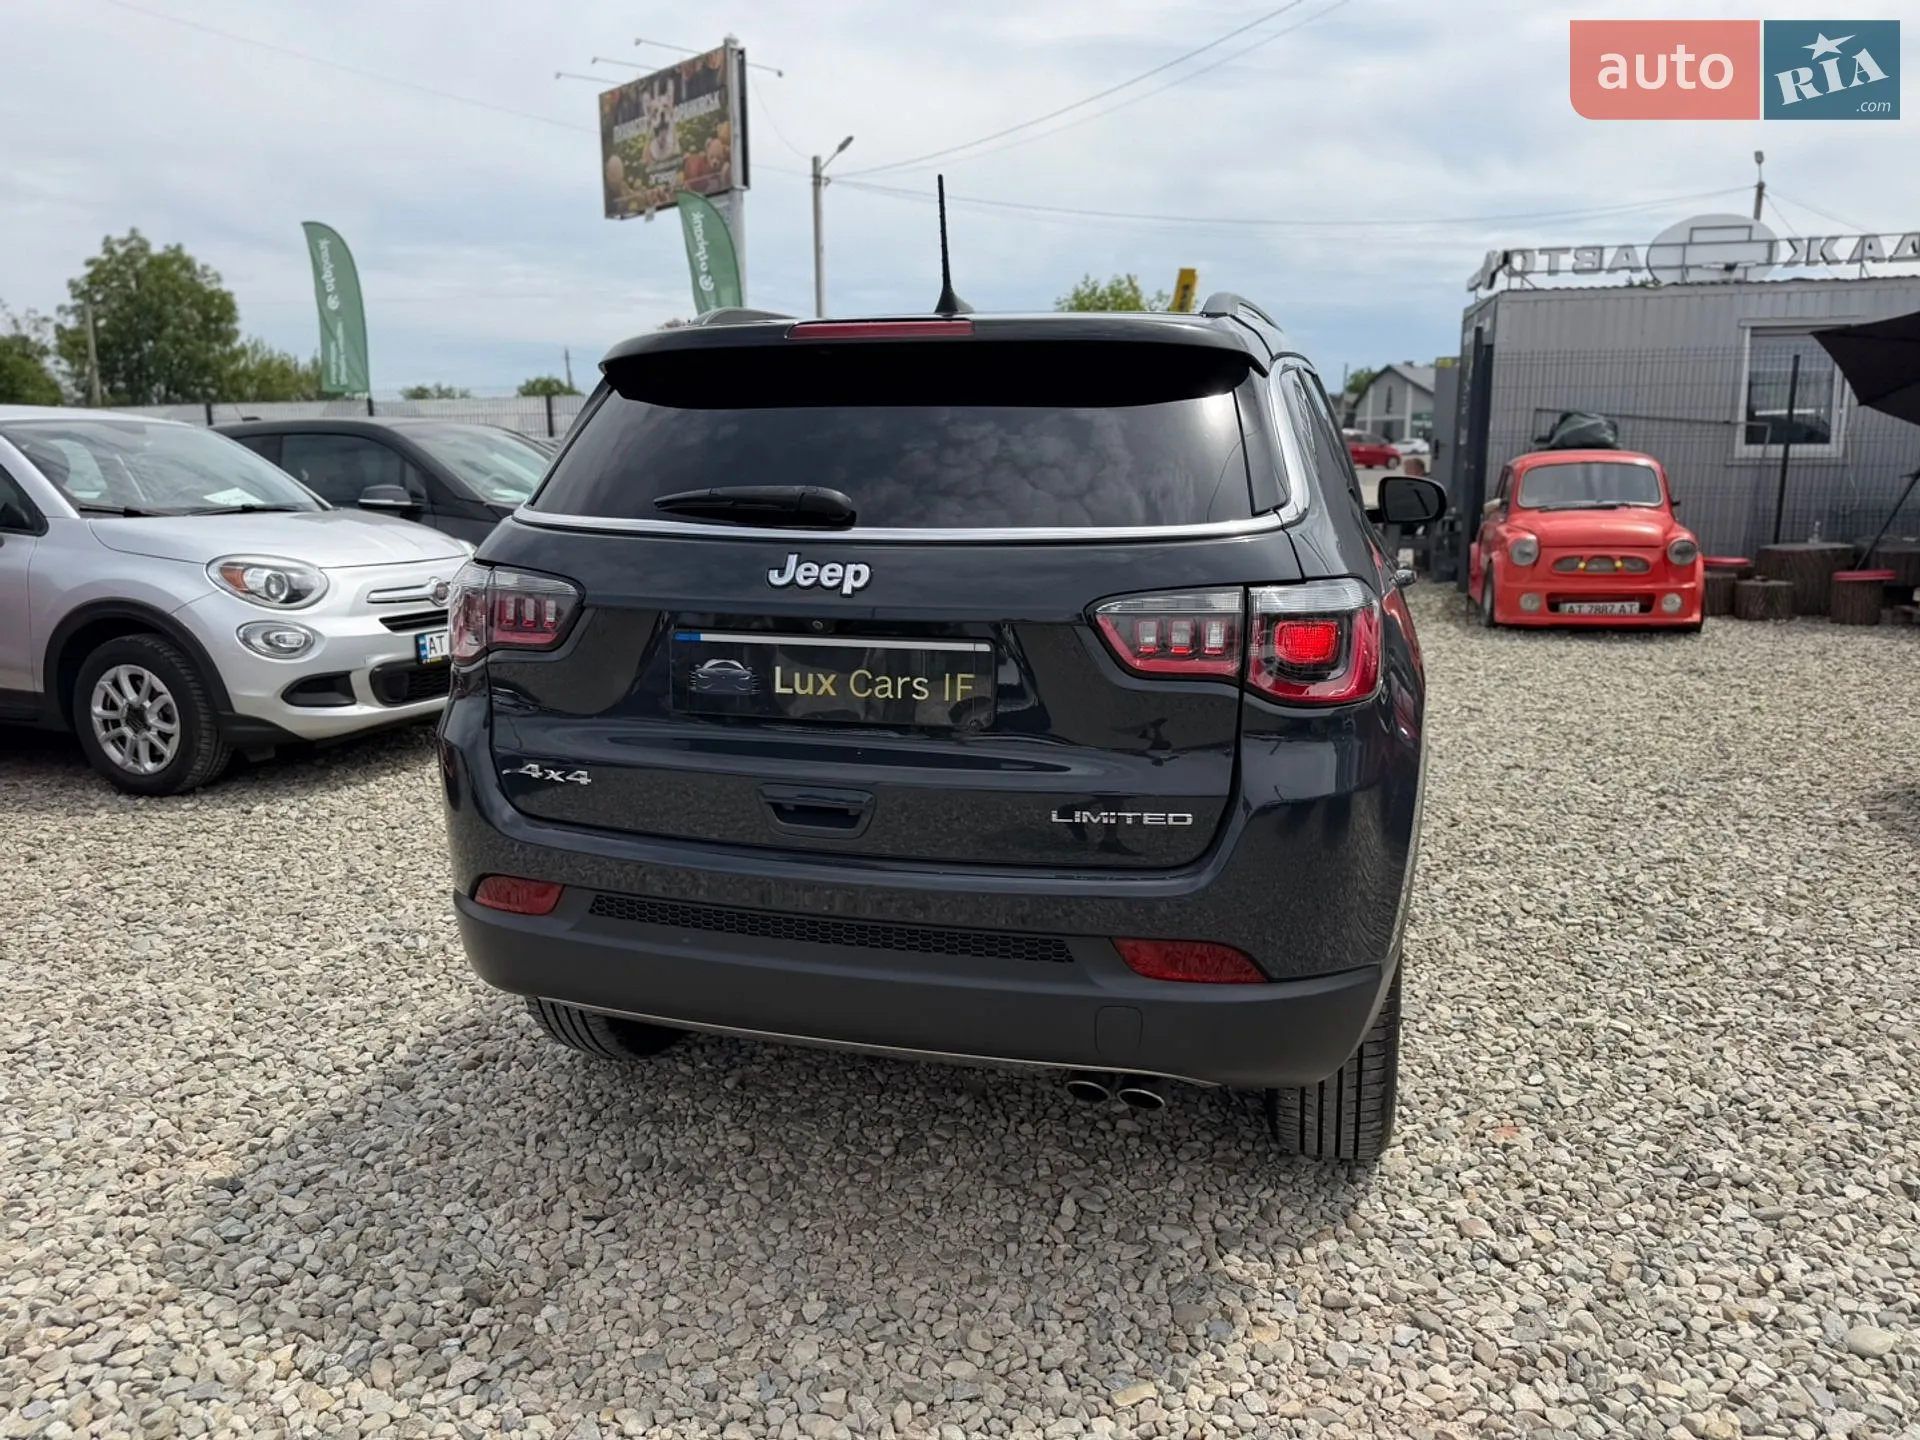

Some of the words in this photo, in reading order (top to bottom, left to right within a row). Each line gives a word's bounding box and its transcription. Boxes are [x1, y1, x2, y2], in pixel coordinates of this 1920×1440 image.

[767, 552, 872, 595] Jeep
[774, 666, 838, 697] Lux
[849, 669, 930, 701] Cars
[943, 672, 976, 701] IF
[518, 763, 592, 785] 4x4
[1051, 809, 1193, 826] LIMITED
